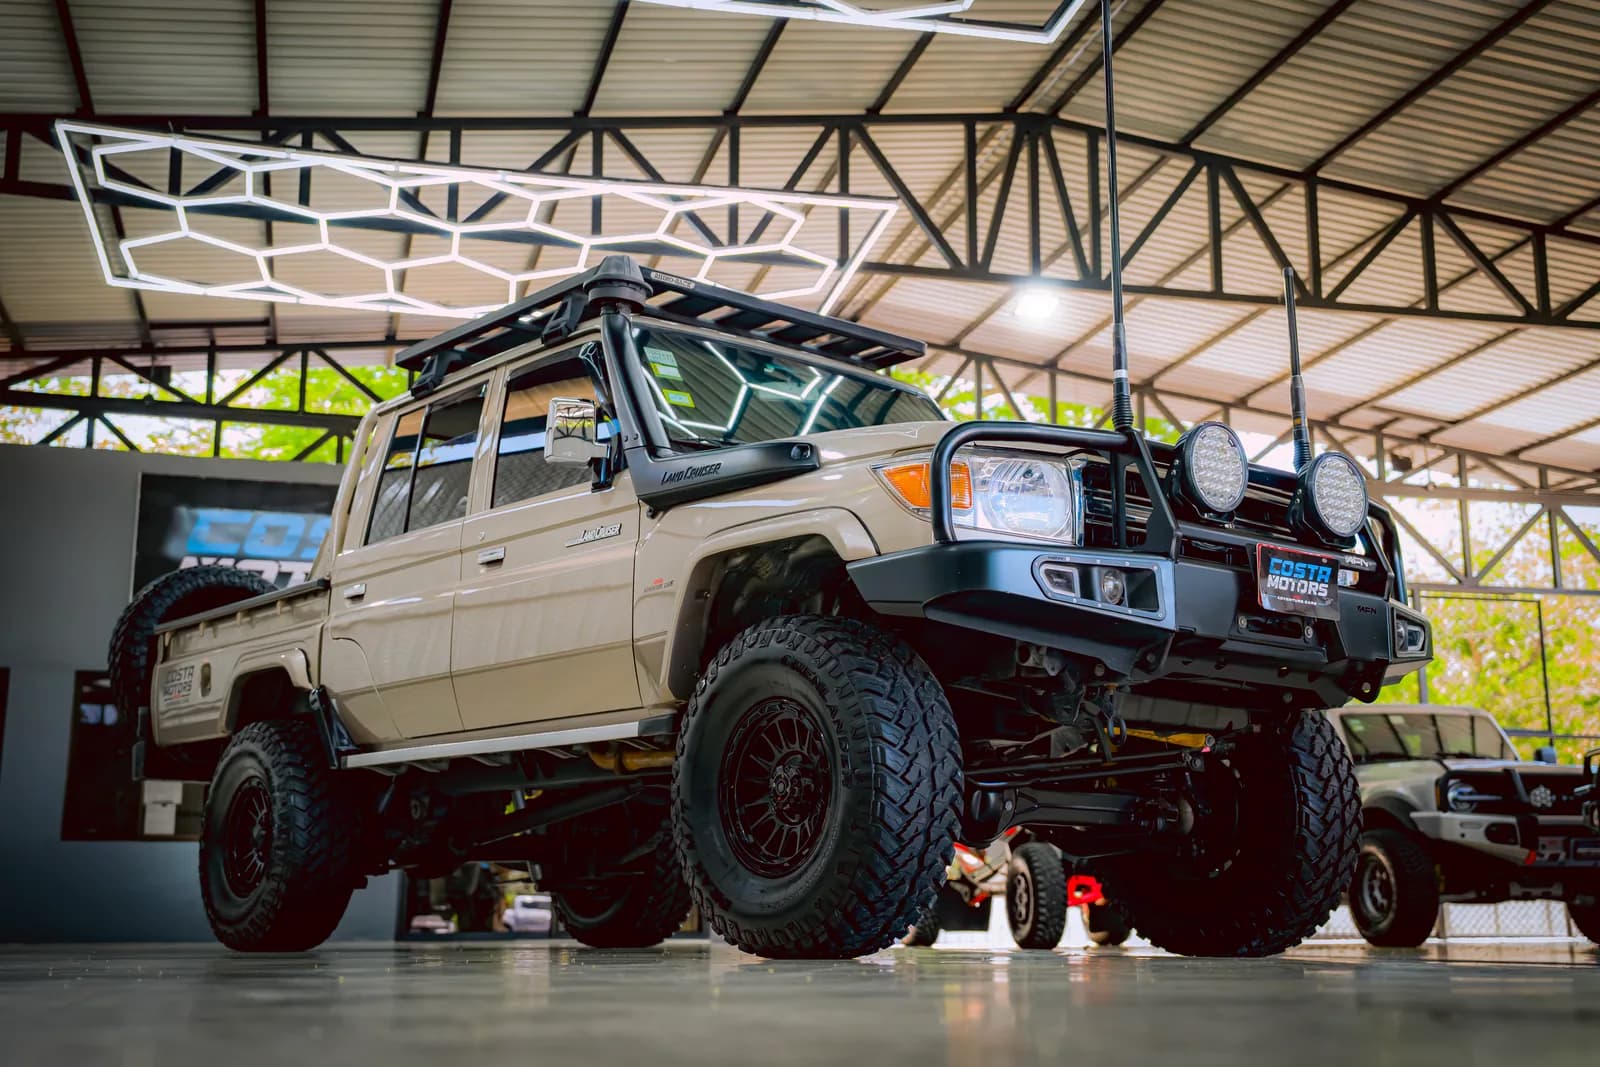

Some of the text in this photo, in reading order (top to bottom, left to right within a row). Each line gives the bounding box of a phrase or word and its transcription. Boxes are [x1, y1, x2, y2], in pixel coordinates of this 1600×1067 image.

[661, 462, 722, 485] LAND CRUISER
[1268, 557, 1332, 583] COSTA
[1267, 574, 1329, 597] MOTORS
[167, 666, 194, 682] COSTA
[164, 680, 192, 697] MOTORS
